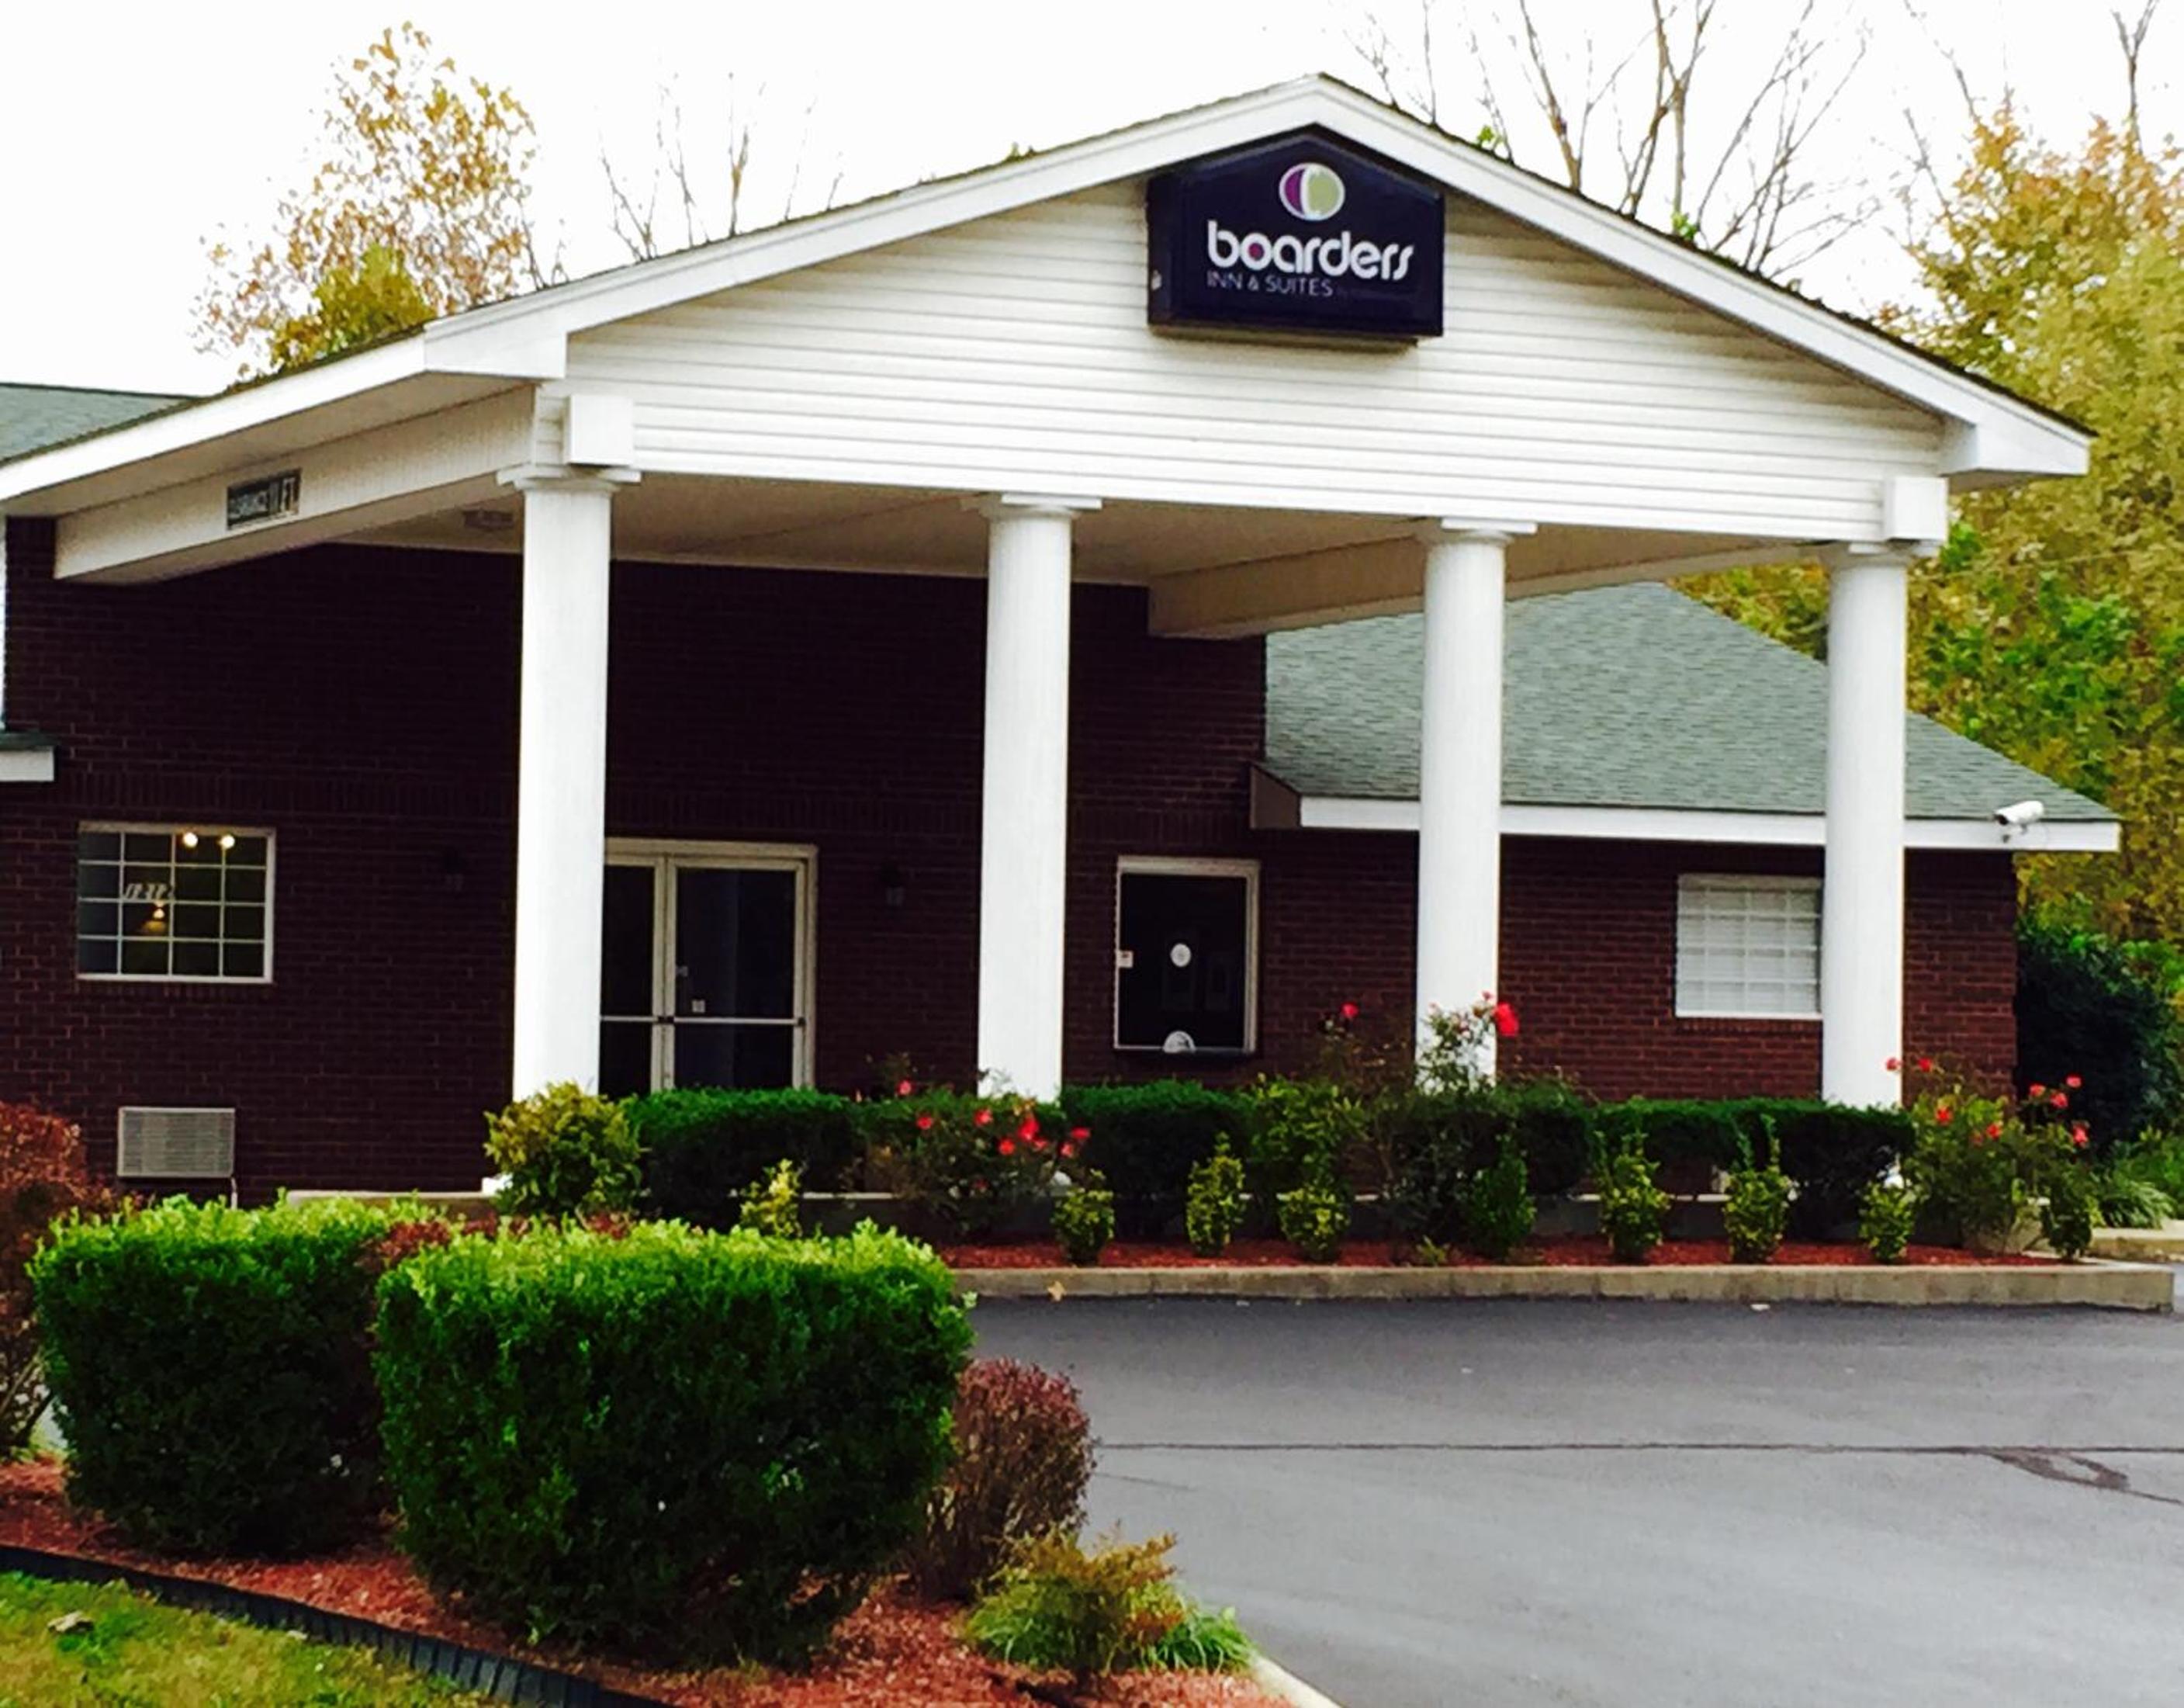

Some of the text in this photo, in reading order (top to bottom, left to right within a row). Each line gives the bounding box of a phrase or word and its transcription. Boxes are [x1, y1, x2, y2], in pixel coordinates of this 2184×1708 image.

[1208, 220, 1414, 280] boarders
[1206, 271, 1334, 297] INN & SUITES
